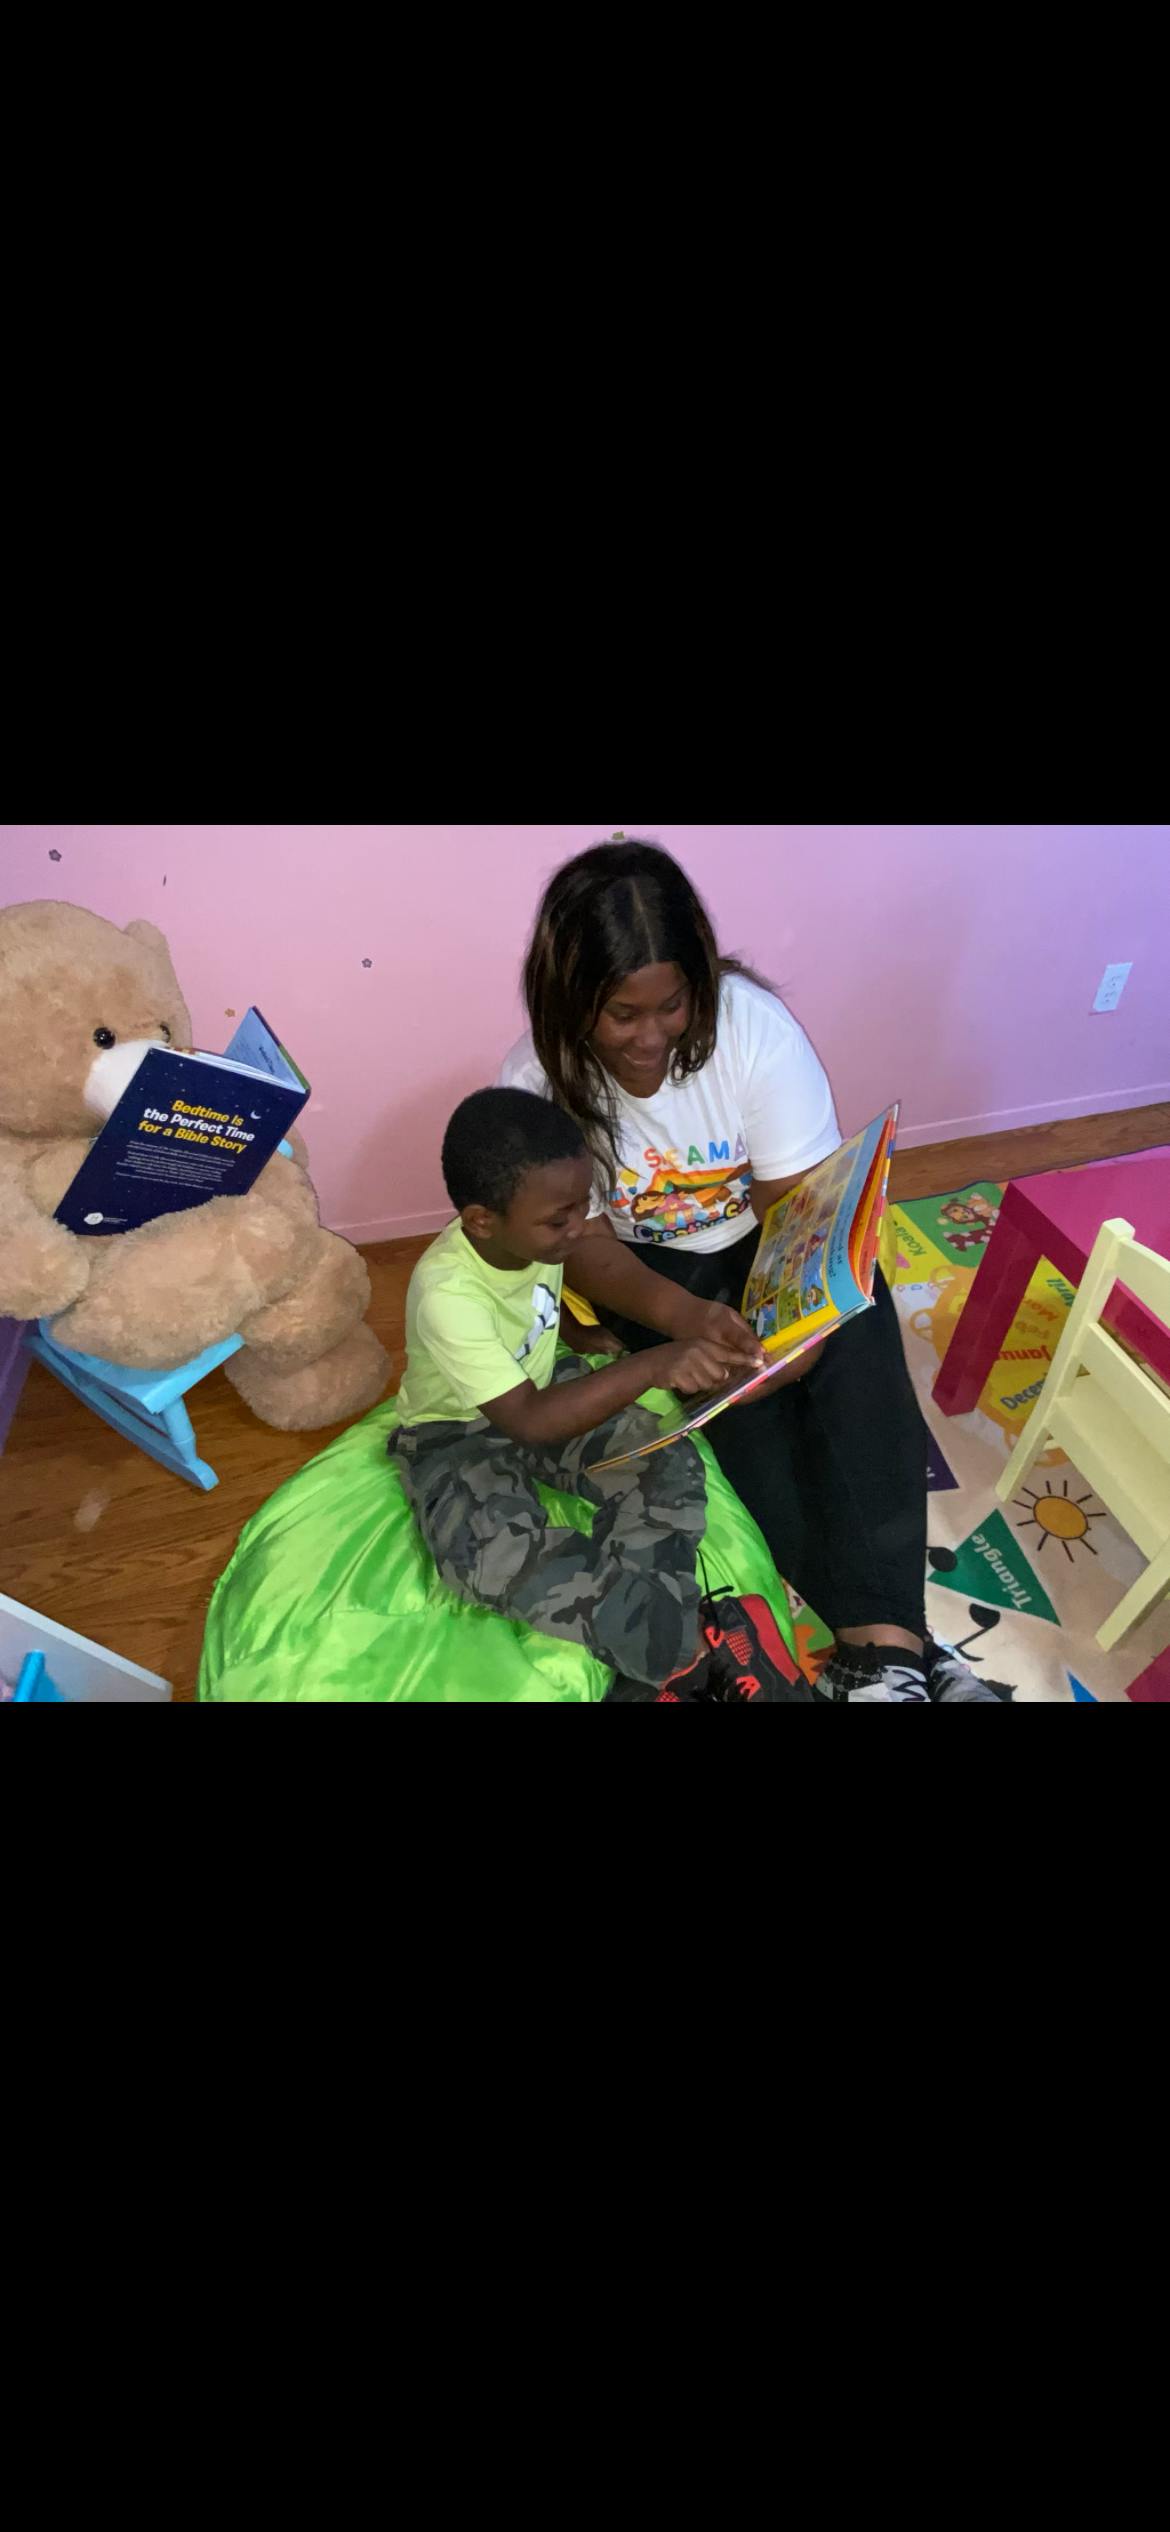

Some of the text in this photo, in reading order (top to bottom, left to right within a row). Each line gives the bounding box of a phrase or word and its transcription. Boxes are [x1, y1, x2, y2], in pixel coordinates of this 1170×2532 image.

[143, 1107, 256, 1142] the Perfect Time
[172, 1099, 230, 1123] Bedtime
[138, 1120, 162, 1134] for
[162, 1128, 173, 1137] a
[174, 1128, 209, 1144] Bible
[210, 1135, 248, 1154] Story
[896, 1226, 927, 1256] Koala
[997, 1345, 1051, 1361] Janu
[971, 1533, 1033, 1609] Triangle
